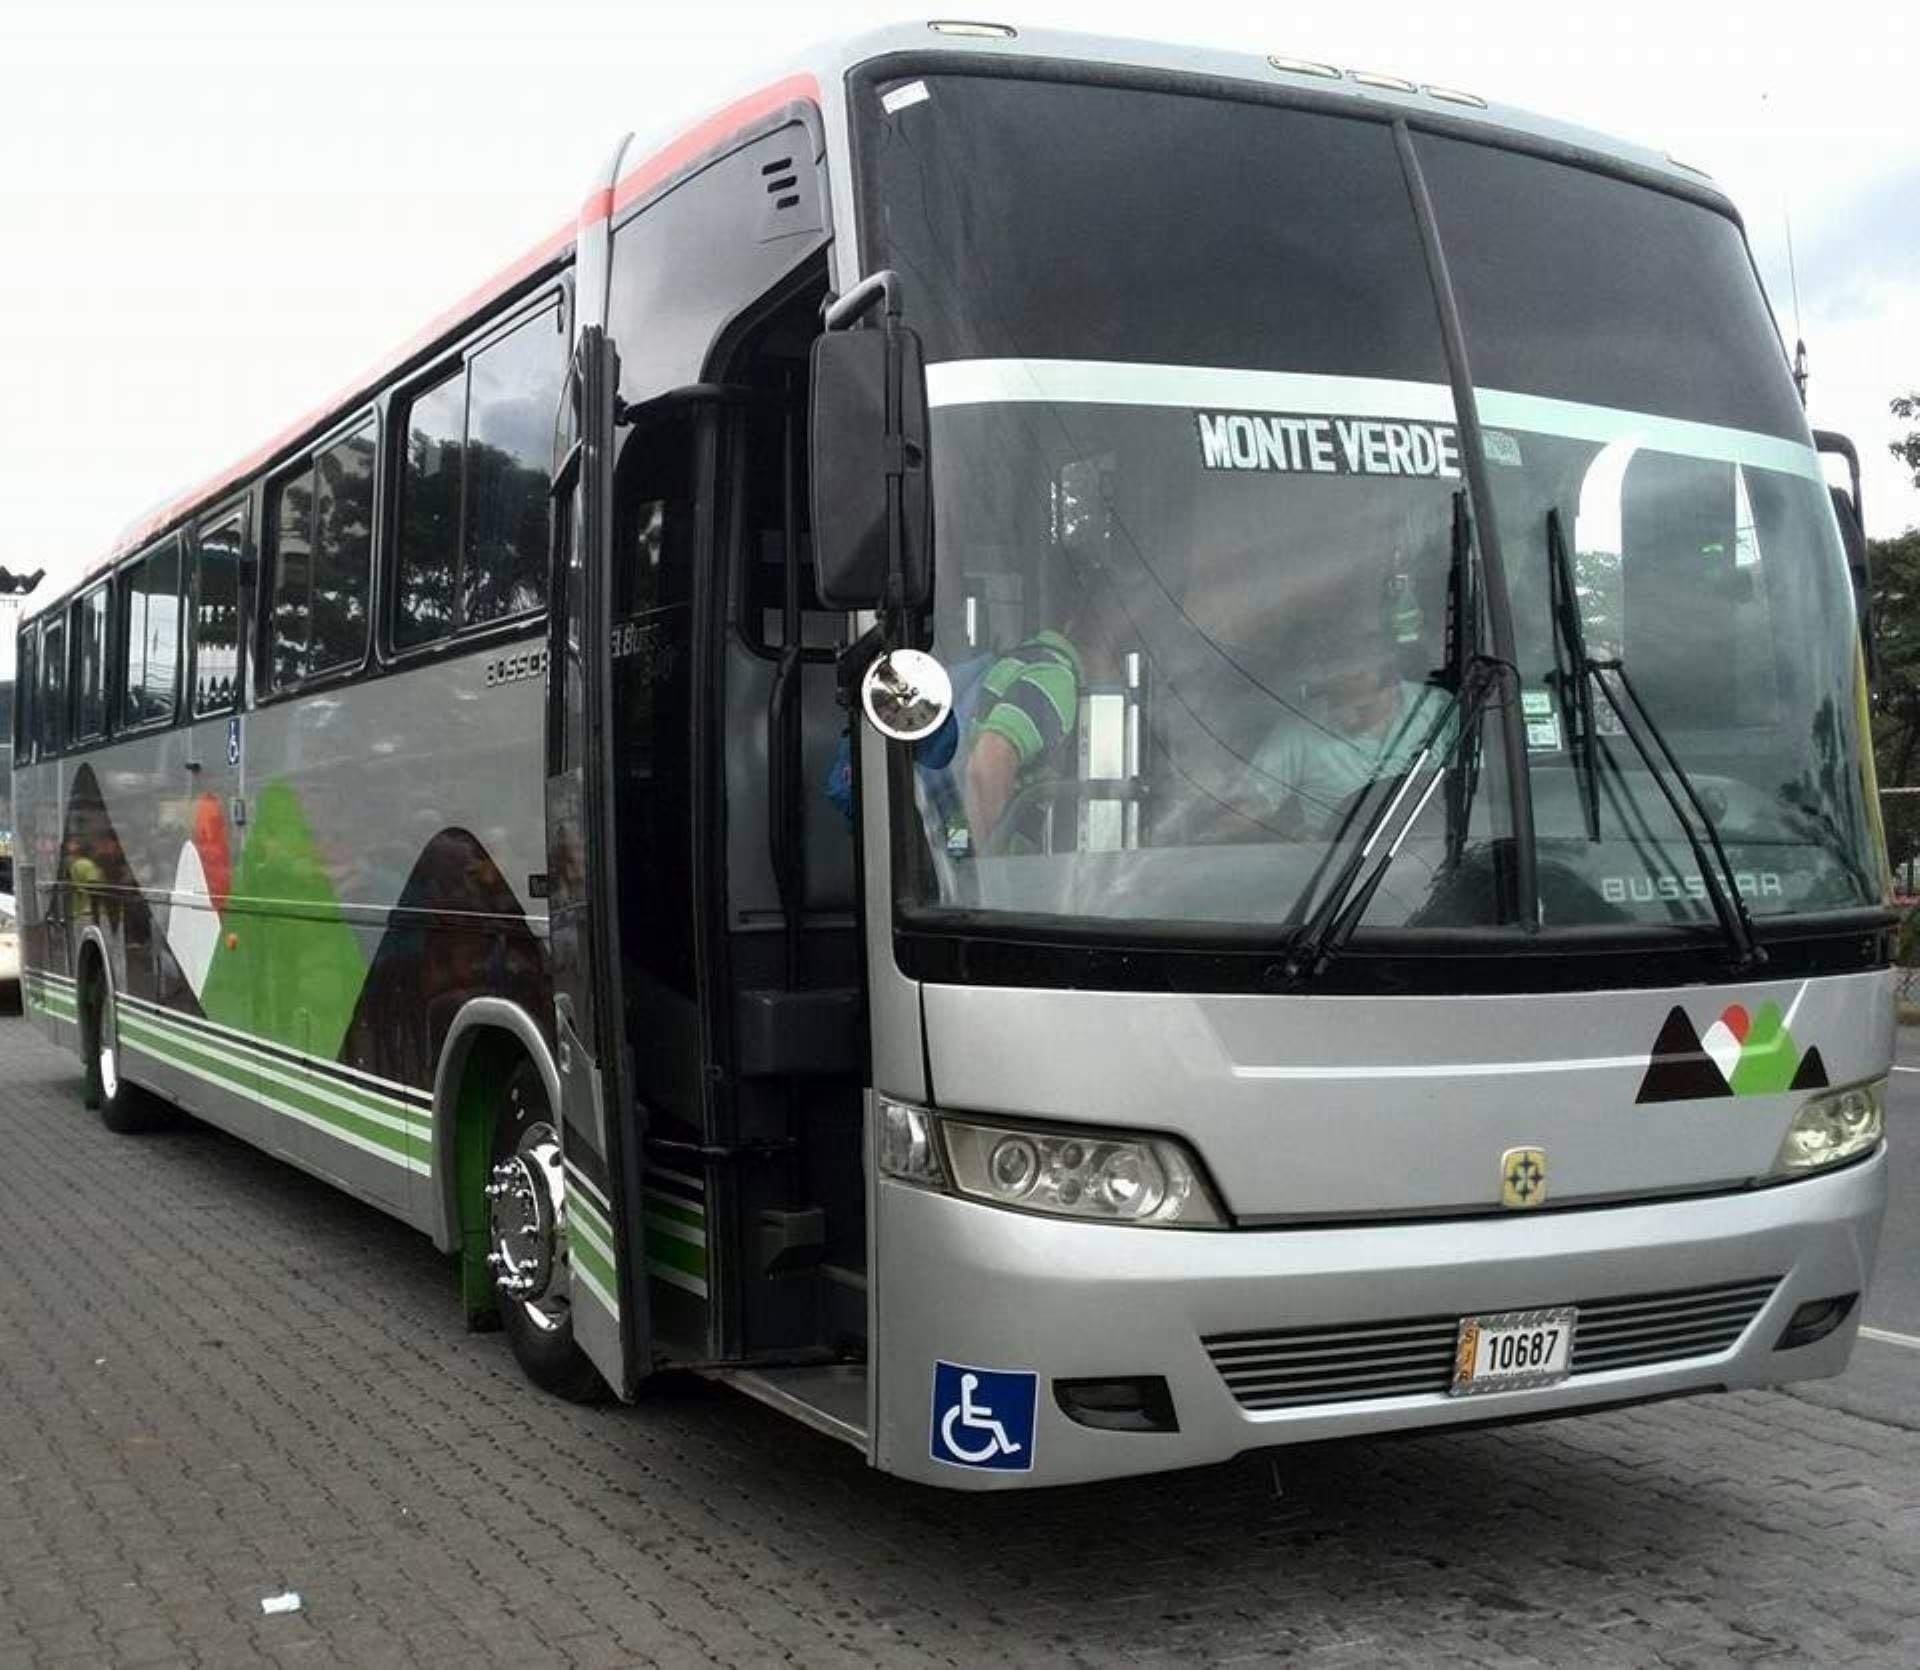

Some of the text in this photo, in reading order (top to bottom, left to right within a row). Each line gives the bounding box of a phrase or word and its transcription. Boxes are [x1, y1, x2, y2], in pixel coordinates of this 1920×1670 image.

[1199, 413, 1336, 473] MONTE
[1335, 419, 1462, 478] VERDE
[1488, 1329, 1559, 1370] 10687
